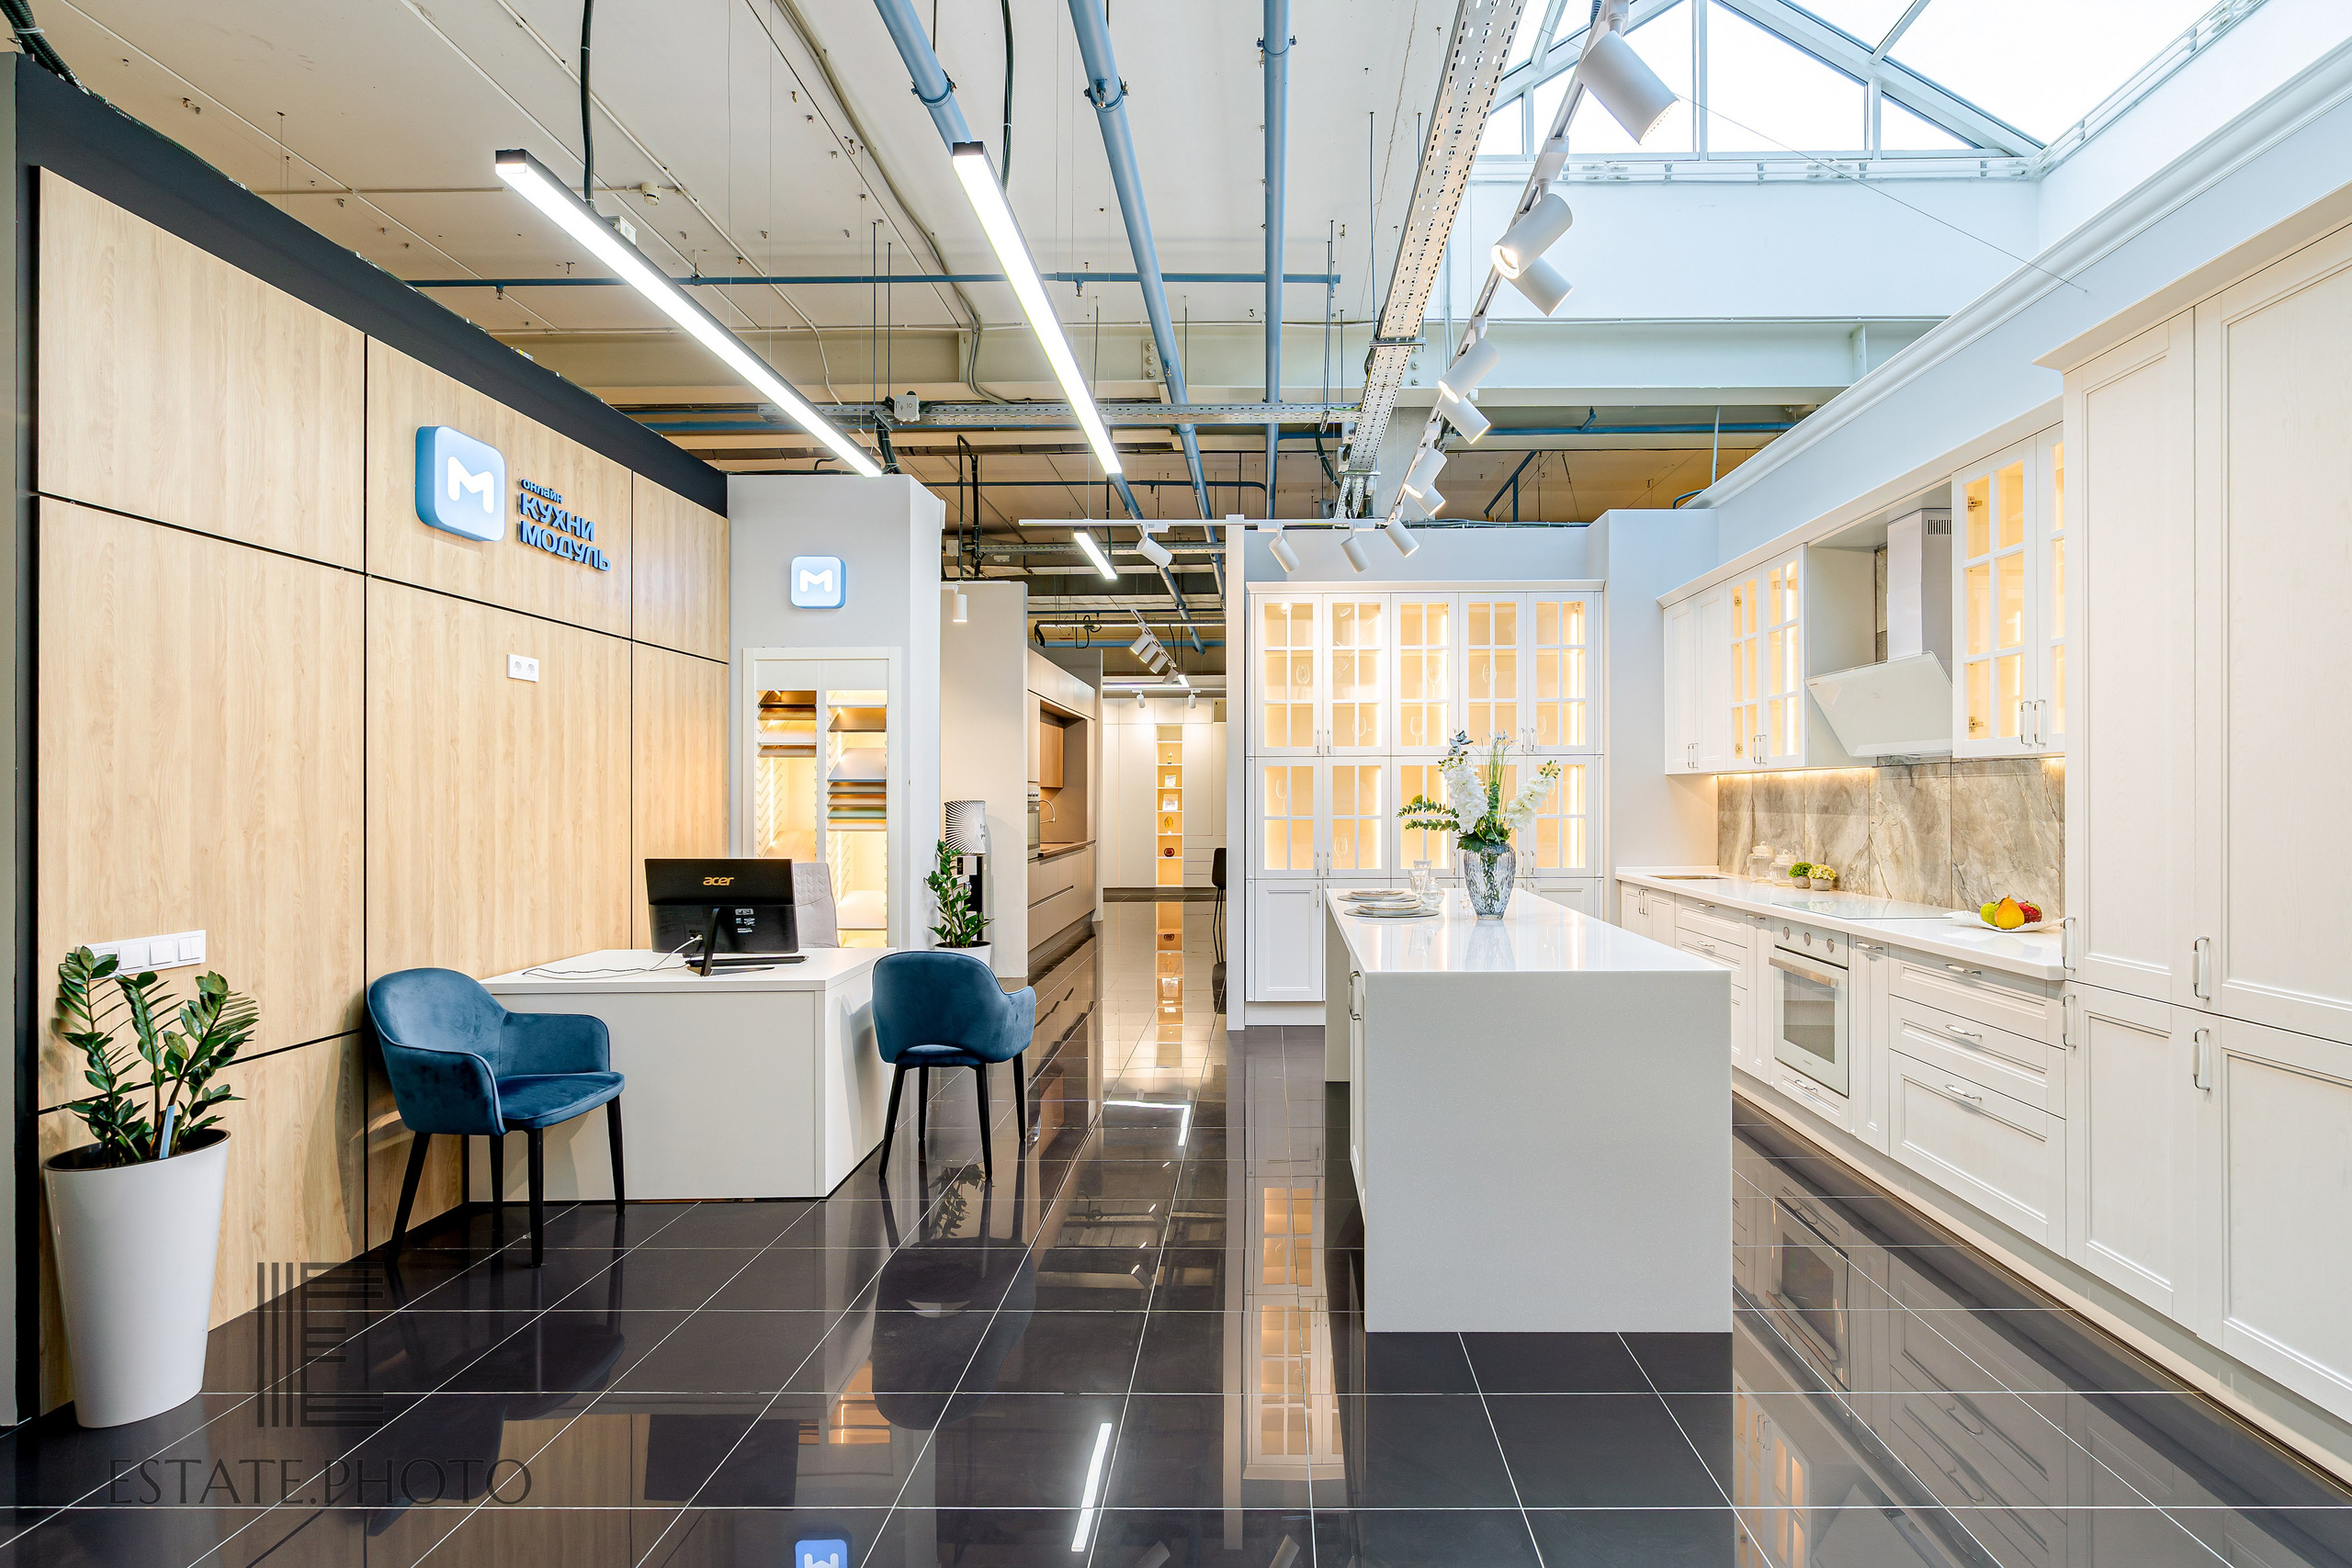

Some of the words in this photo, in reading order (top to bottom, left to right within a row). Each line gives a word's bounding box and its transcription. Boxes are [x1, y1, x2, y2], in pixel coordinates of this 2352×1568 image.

[520, 479, 563, 504] онлайн
[520, 492, 594, 542] КУХНИ
[520, 520, 611, 571] МОДУЛЬ
[703, 876, 735, 886] acer
